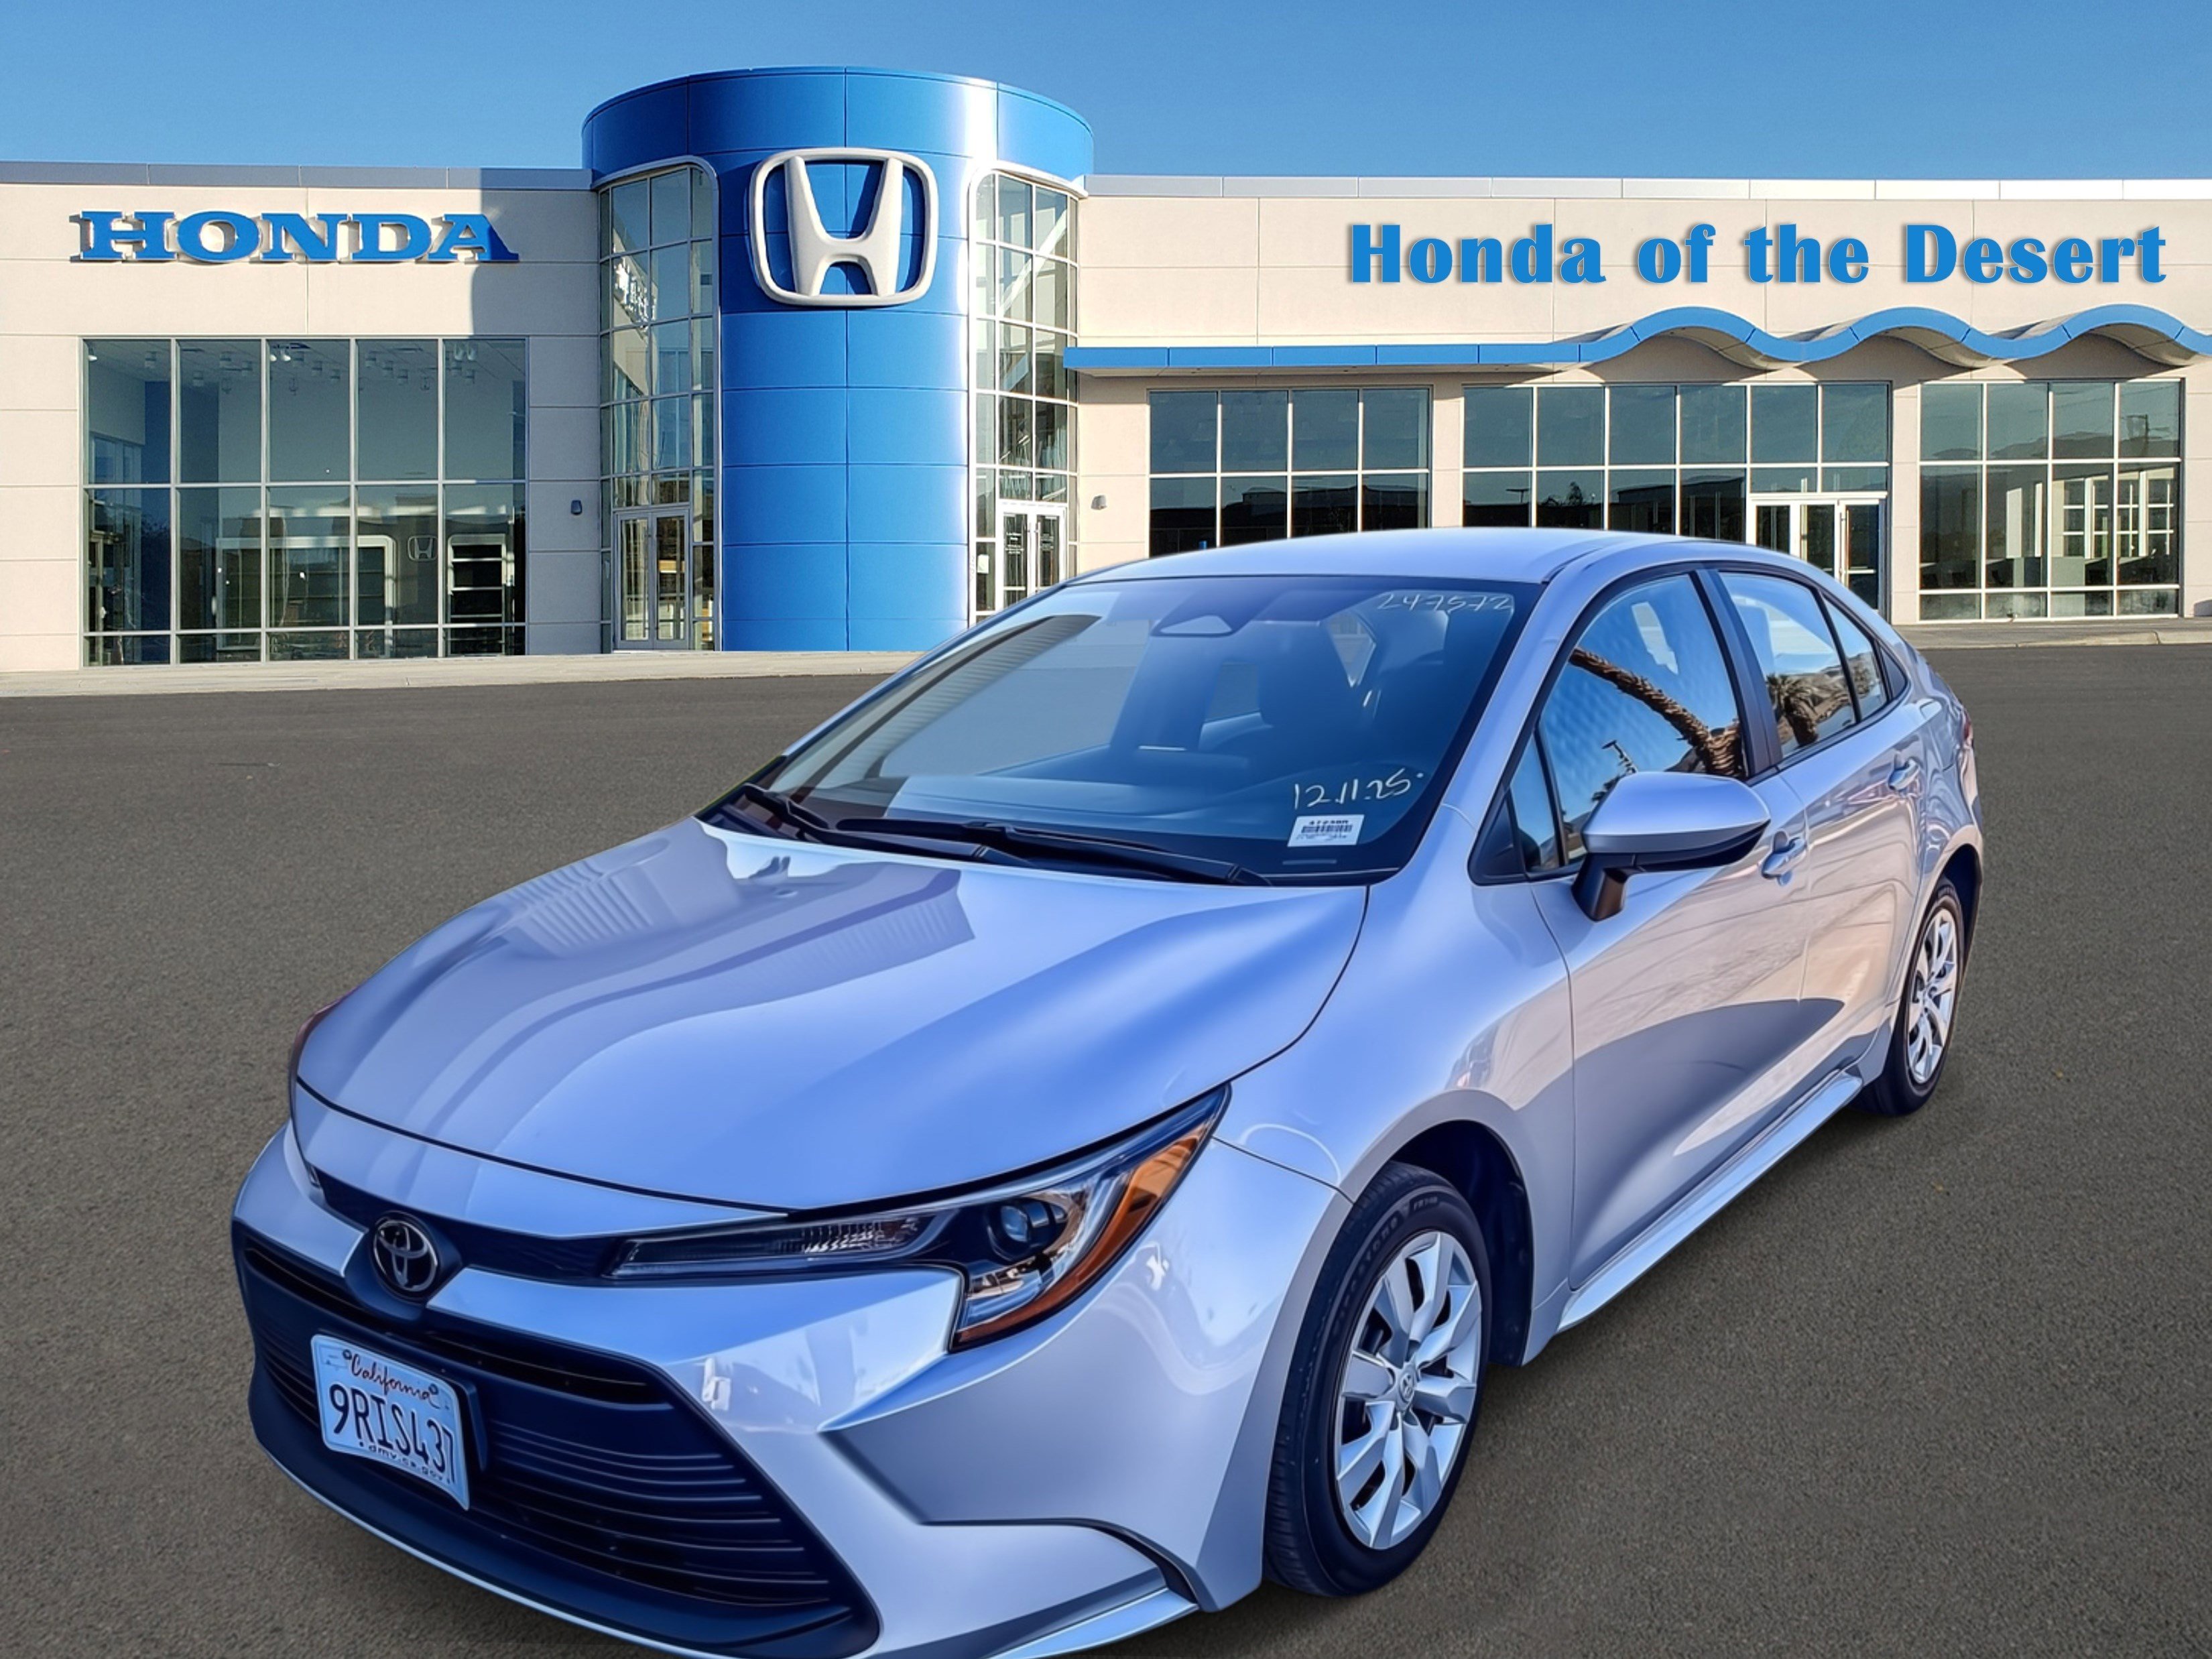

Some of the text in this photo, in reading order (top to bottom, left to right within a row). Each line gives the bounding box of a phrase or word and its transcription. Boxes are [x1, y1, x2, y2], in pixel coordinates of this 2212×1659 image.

[82, 212, 518, 262] HONDA
[1353, 225, 2165, 283] Honda of the Desert
[350, 1353, 441, 1409] California
[328, 1384, 455, 1483] 9RIS437
